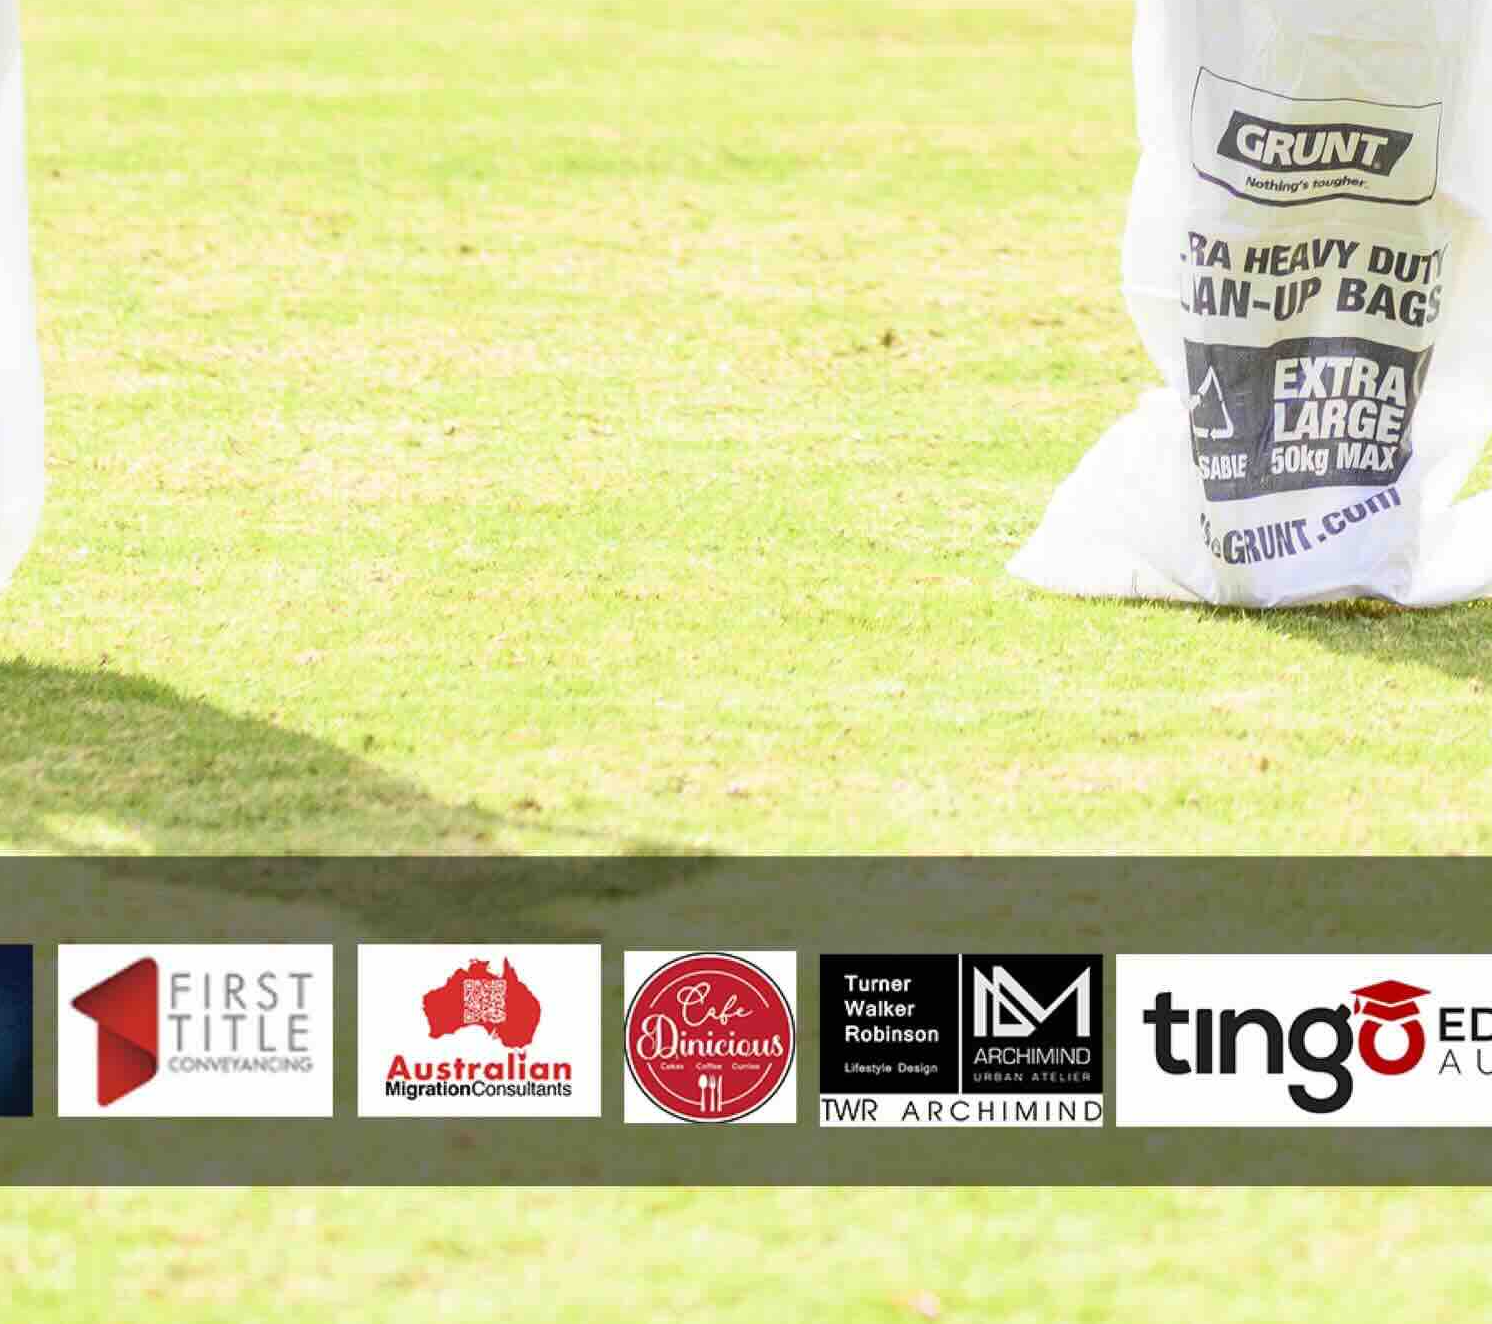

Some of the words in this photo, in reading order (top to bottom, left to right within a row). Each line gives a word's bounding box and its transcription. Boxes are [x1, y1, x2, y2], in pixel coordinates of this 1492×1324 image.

[1237, 123, 1389, 167] GRUNT
[1245, 176, 1308, 193] Nothing's
[1180, 231, 1231, 270] RA
[1244, 238, 1360, 276] HEAVY
[1367, 243, 1449, 284] DUTY
[1336, 277, 1443, 328] BAGS
[1274, 356, 1407, 407] EXTRA
[1274, 399, 1406, 444] LARGE
[1270, 445, 1330, 476] 50kg
[1336, 442, 1398, 472] MAX
